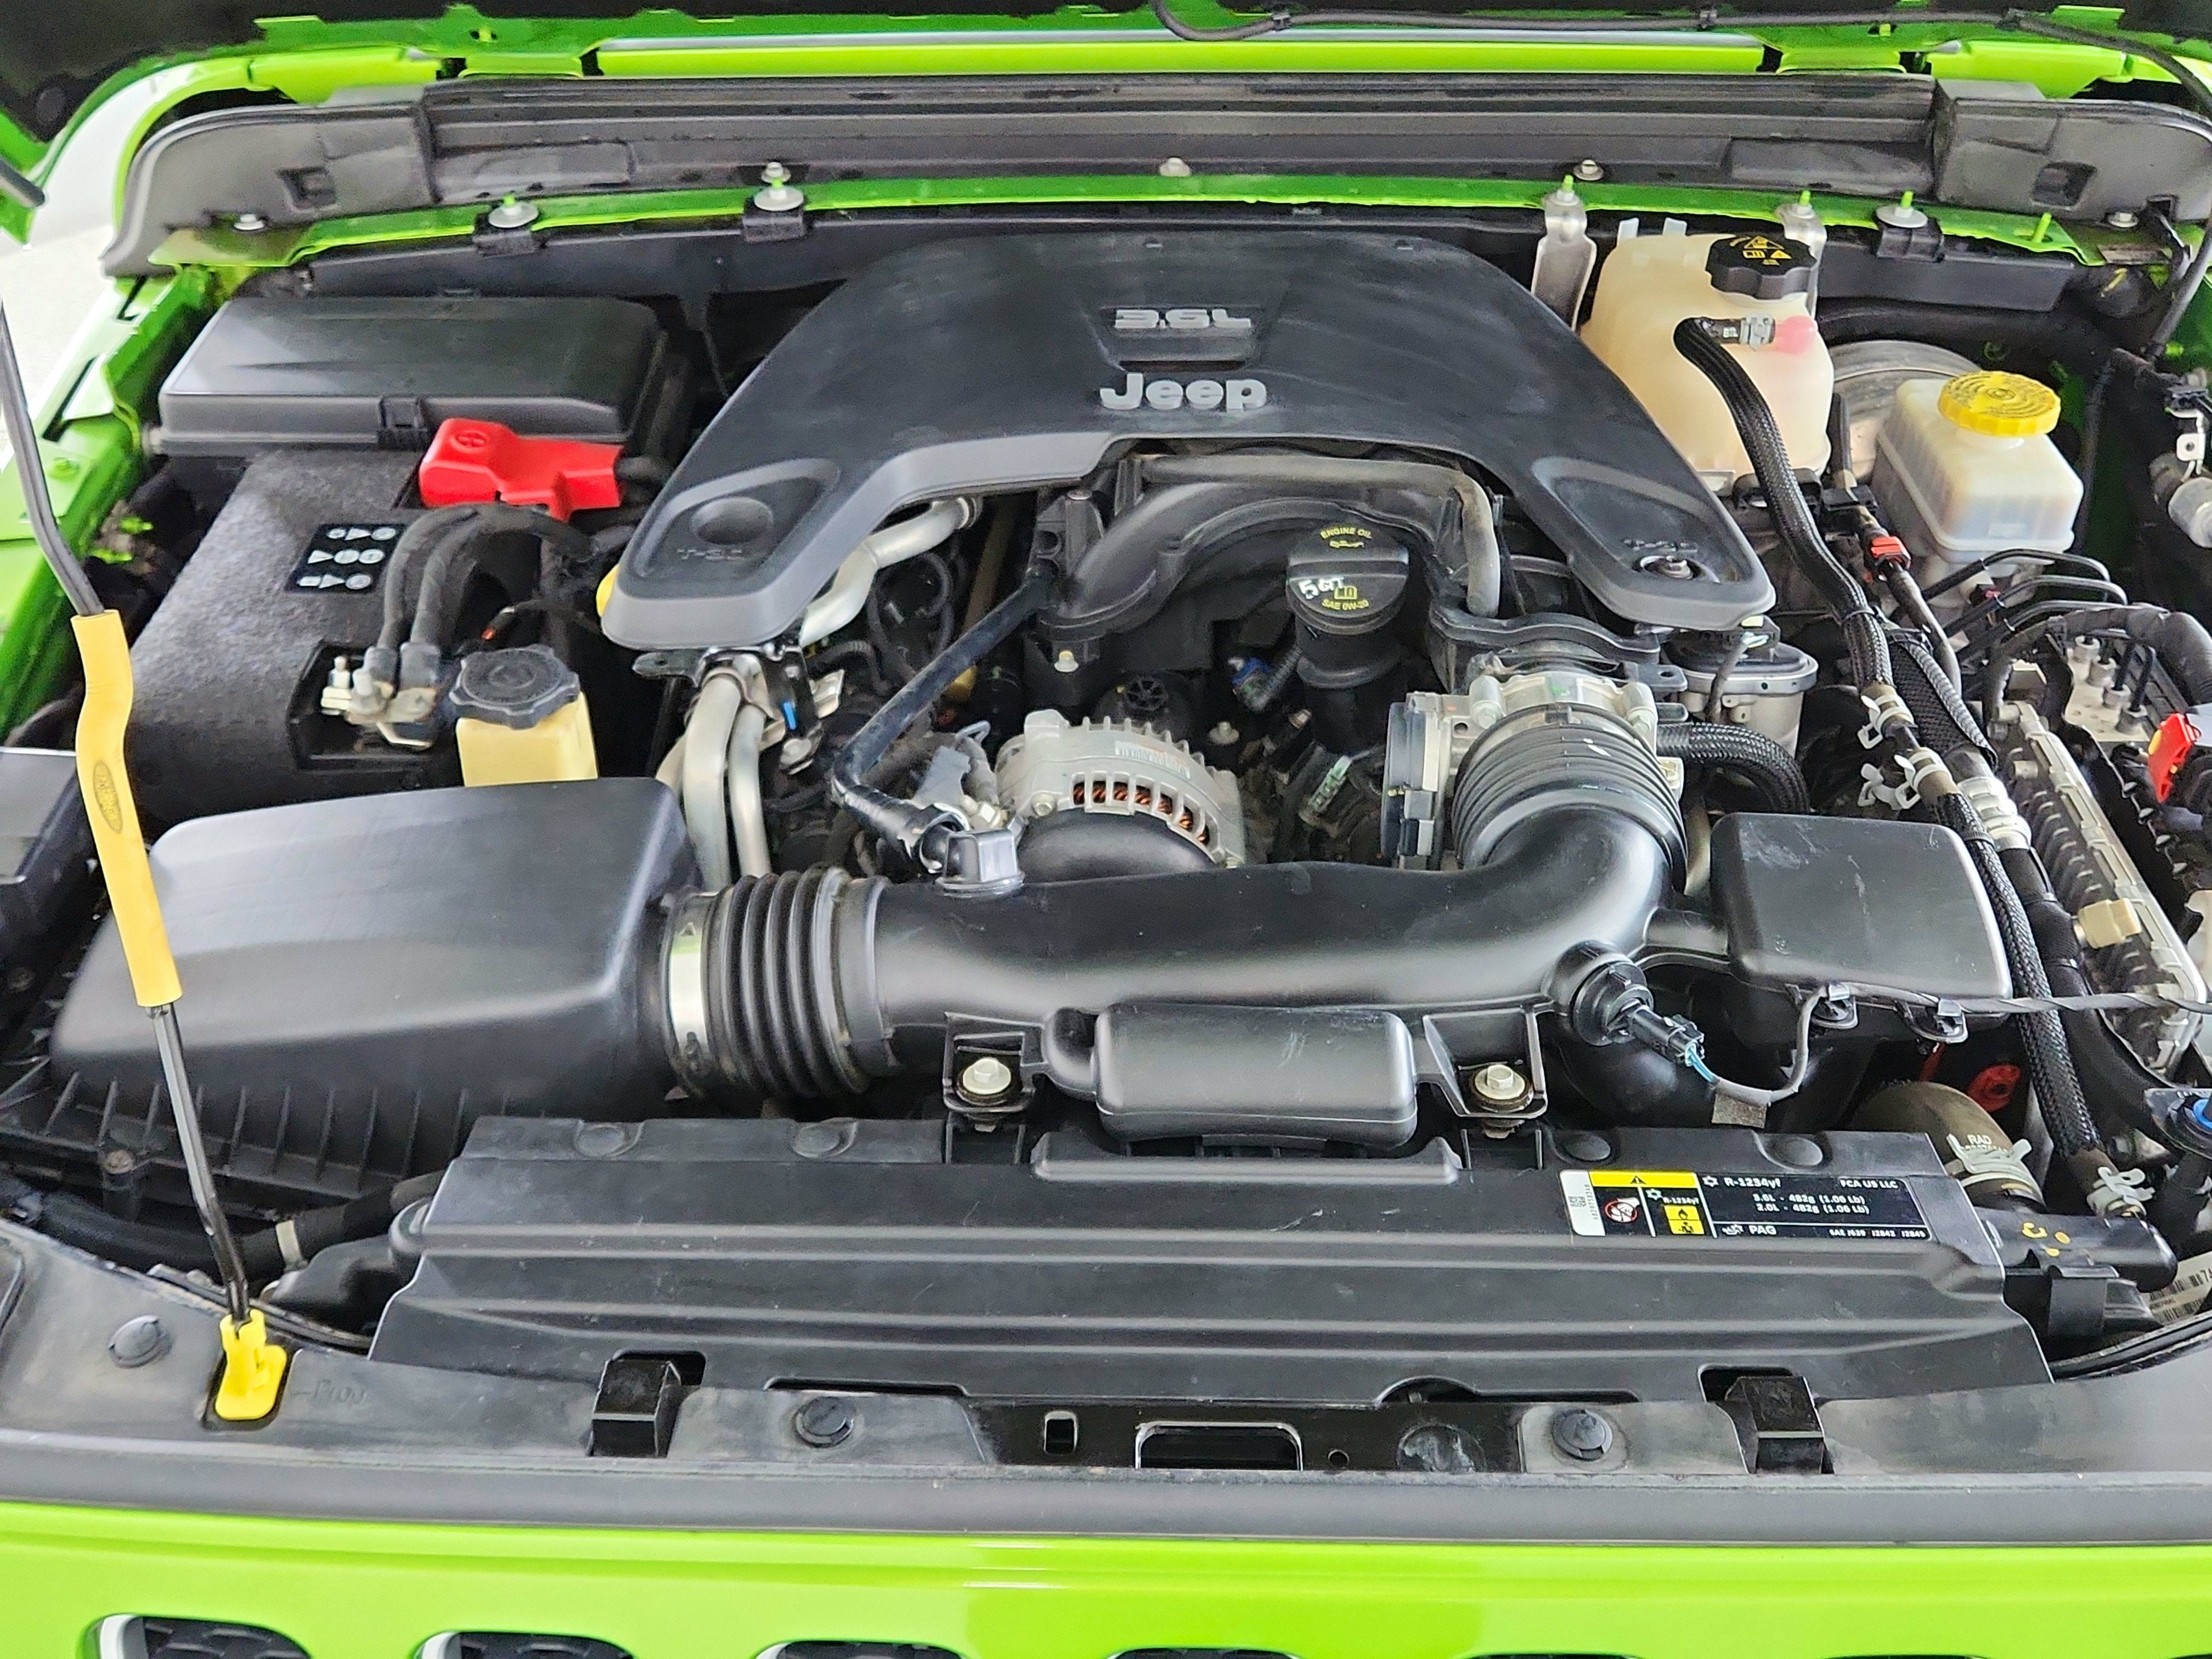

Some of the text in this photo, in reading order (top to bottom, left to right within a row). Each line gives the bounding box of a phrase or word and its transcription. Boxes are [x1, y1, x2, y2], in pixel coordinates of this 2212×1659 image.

[1114, 309, 1251, 329] 3.6L
[1099, 373, 1267, 412] Jeep
[1320, 527, 1372, 539] ENGINE OIL
[1322, 599, 1340, 610] SAE
[1967, 1134, 1992, 1145] RAD
[1724, 1177, 1781, 1189] R-1234yf
[1756, 1203, 1780, 1211] 2.0L
[1748, 1225, 1777, 1235] PAG
